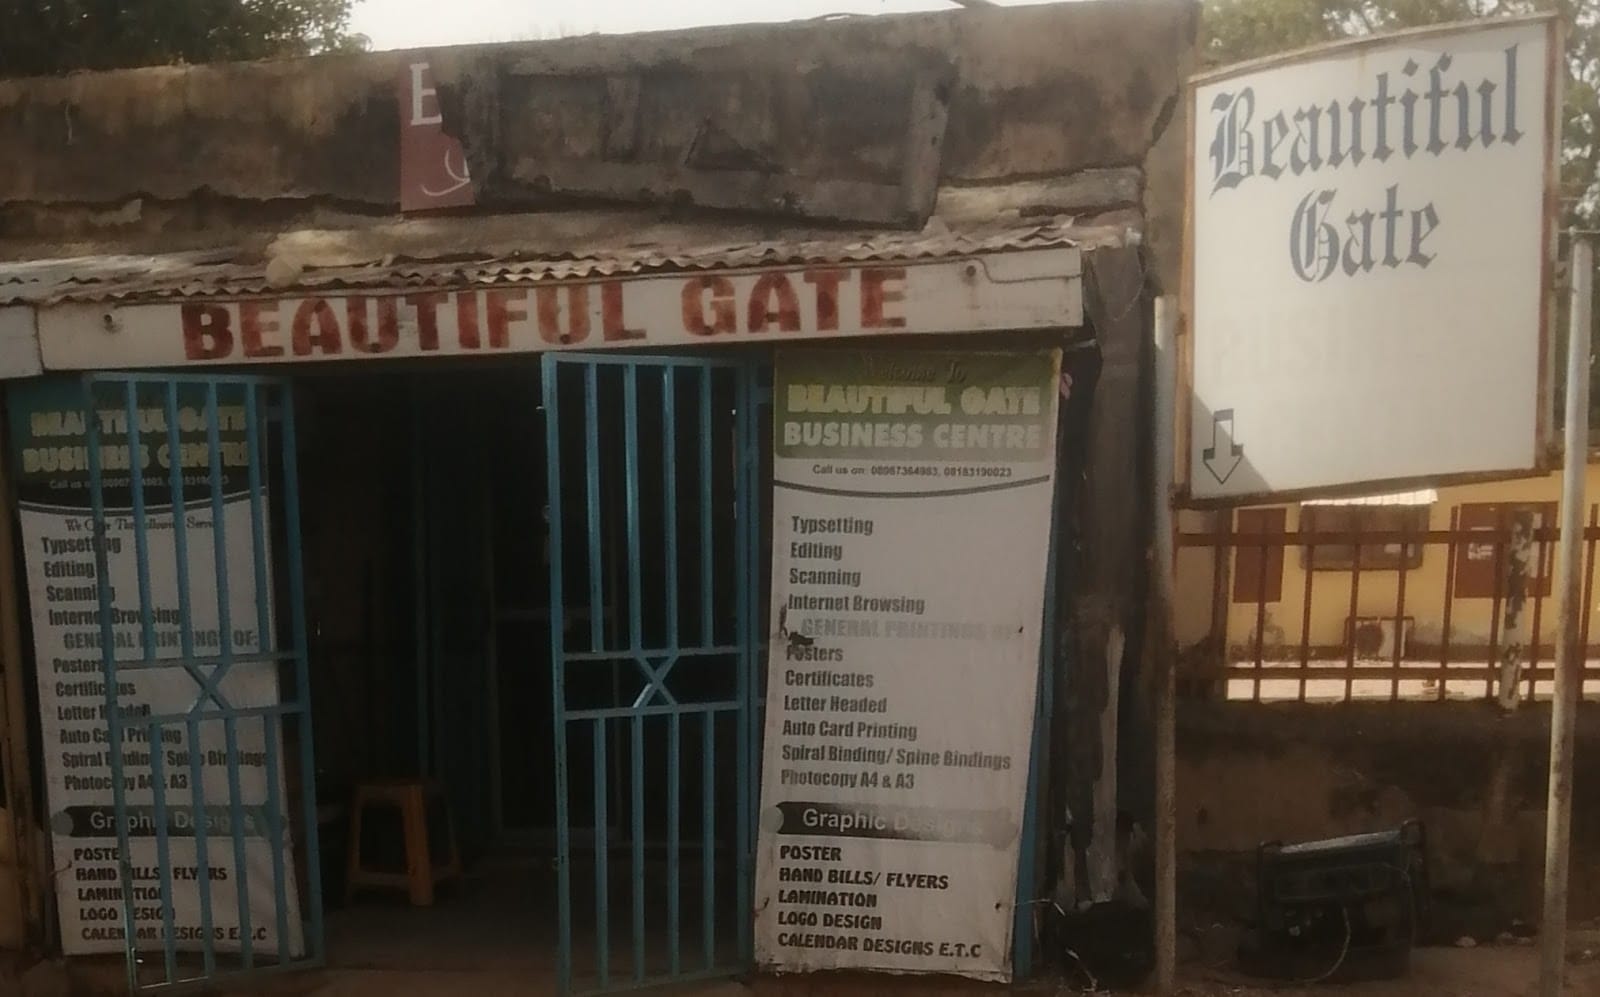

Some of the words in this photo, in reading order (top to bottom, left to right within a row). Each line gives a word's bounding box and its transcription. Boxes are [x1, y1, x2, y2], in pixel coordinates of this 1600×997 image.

[1209, 43, 1526, 199] Beautiful
[1289, 183, 1440, 283] Gate
[181, 279, 647, 360] BEAUTIFUL
[682, 267, 908, 336] GATE
[787, 384, 951, 415] BEAUTIFUL
[960, 385, 1041, 416] GATE
[784, 421, 923, 448] BUSINESS
[933, 423, 1042, 449] CENTRE
[812, 464, 833, 475] Call
[835, 466, 849, 475] us
[791, 515, 874, 536] Typsetting
[789, 541, 843, 561] Editing
[43, 560, 95, 578] Editing
[788, 568, 861, 587] Scanning
[787, 594, 849, 611] Internet
[852, 595, 926, 615] Browsing
[785, 643, 844, 662] Posters
[784, 669, 875, 688] Certificates
[57, 704, 96, 721] Letter
[783, 695, 827, 712] Letter
[829, 695, 888, 713] Headed
[60, 728, 89, 745] Auto
[781, 719, 816, 737] Auto
[818, 720, 854, 738] Card
[857, 721, 918, 741] Printing
[781, 744, 825, 762] Spiral
[828, 745, 894, 765] Binding/
[895, 748, 941, 767] Spine
[943, 750, 1012, 771] Bindings
[170, 772, 187, 789] A3
[780, 768, 858, 788] Photocopy
[859, 771, 878, 788] A4
[881, 776, 892, 789] &
[895, 772, 915, 790] A3
[802, 809, 886, 832] Graphic
[73, 847, 121, 862] POSTE
[780, 845, 842, 861] POSTER
[779, 867, 823, 883] HAND
[827, 870, 882, 886] BILLS/
[886, 872, 949, 890] FLYERS
[777, 889, 878, 907] LAMINATION
[79, 907, 118, 922] LOGO
[777, 911, 818, 927] LOGO
[823, 914, 882, 930] DESIGN
[777, 933, 858, 950] CALENDAR
[863, 936, 934, 956] DESIGNS
